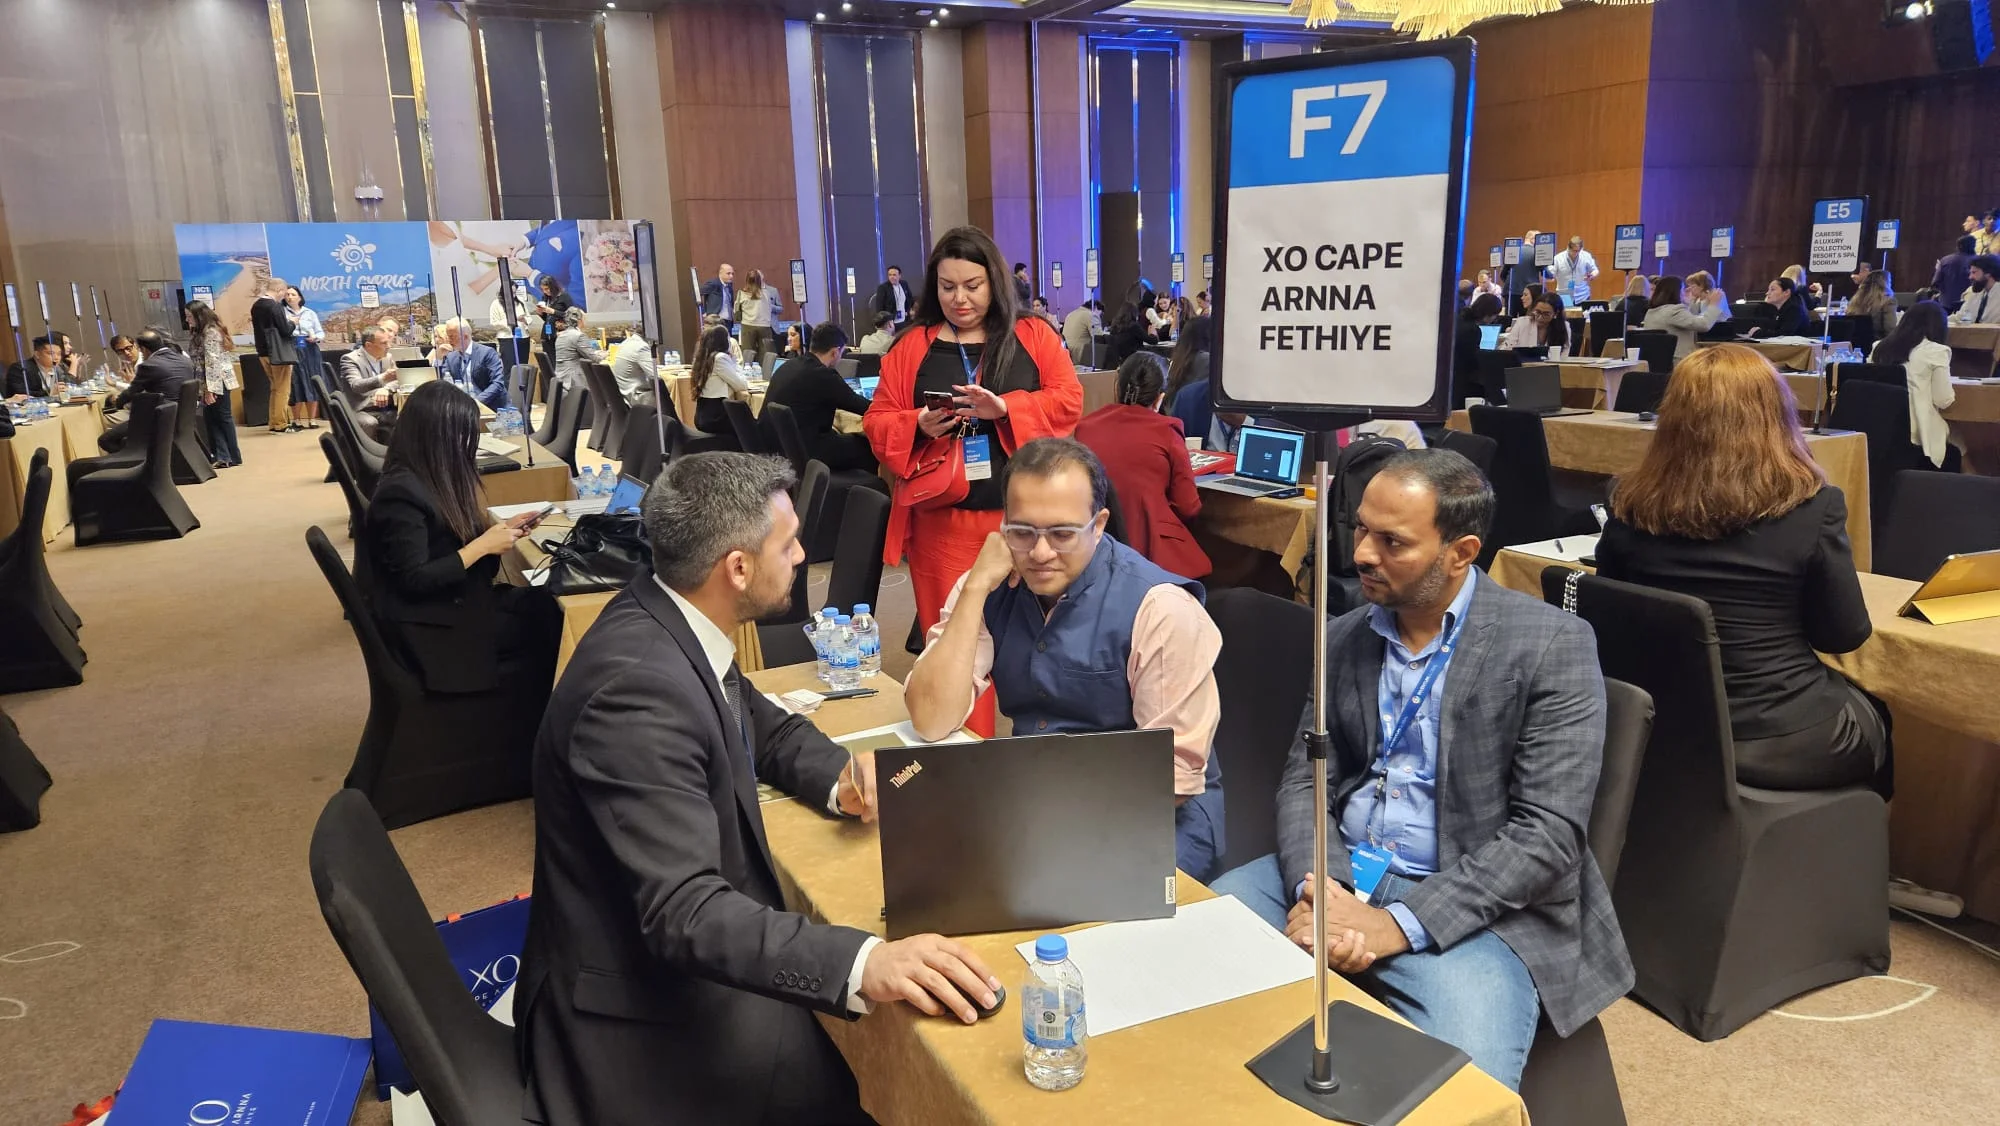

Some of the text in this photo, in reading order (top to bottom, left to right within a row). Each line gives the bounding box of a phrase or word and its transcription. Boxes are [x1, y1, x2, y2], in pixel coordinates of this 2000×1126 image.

[1289, 79, 1388, 159] F7
[1827, 202, 1851, 219] E5
[1622, 227, 1637, 238] D4
[1262, 241, 1404, 273] XO CAPE
[299, 275, 353, 293] NORTH
[1260, 284, 1376, 312] ARNNA
[1259, 324, 1392, 351] FETHIYE
[889, 759, 923, 789] ThinkPad
[468, 954, 521, 993] XO
[186, 1100, 231, 1126] O
